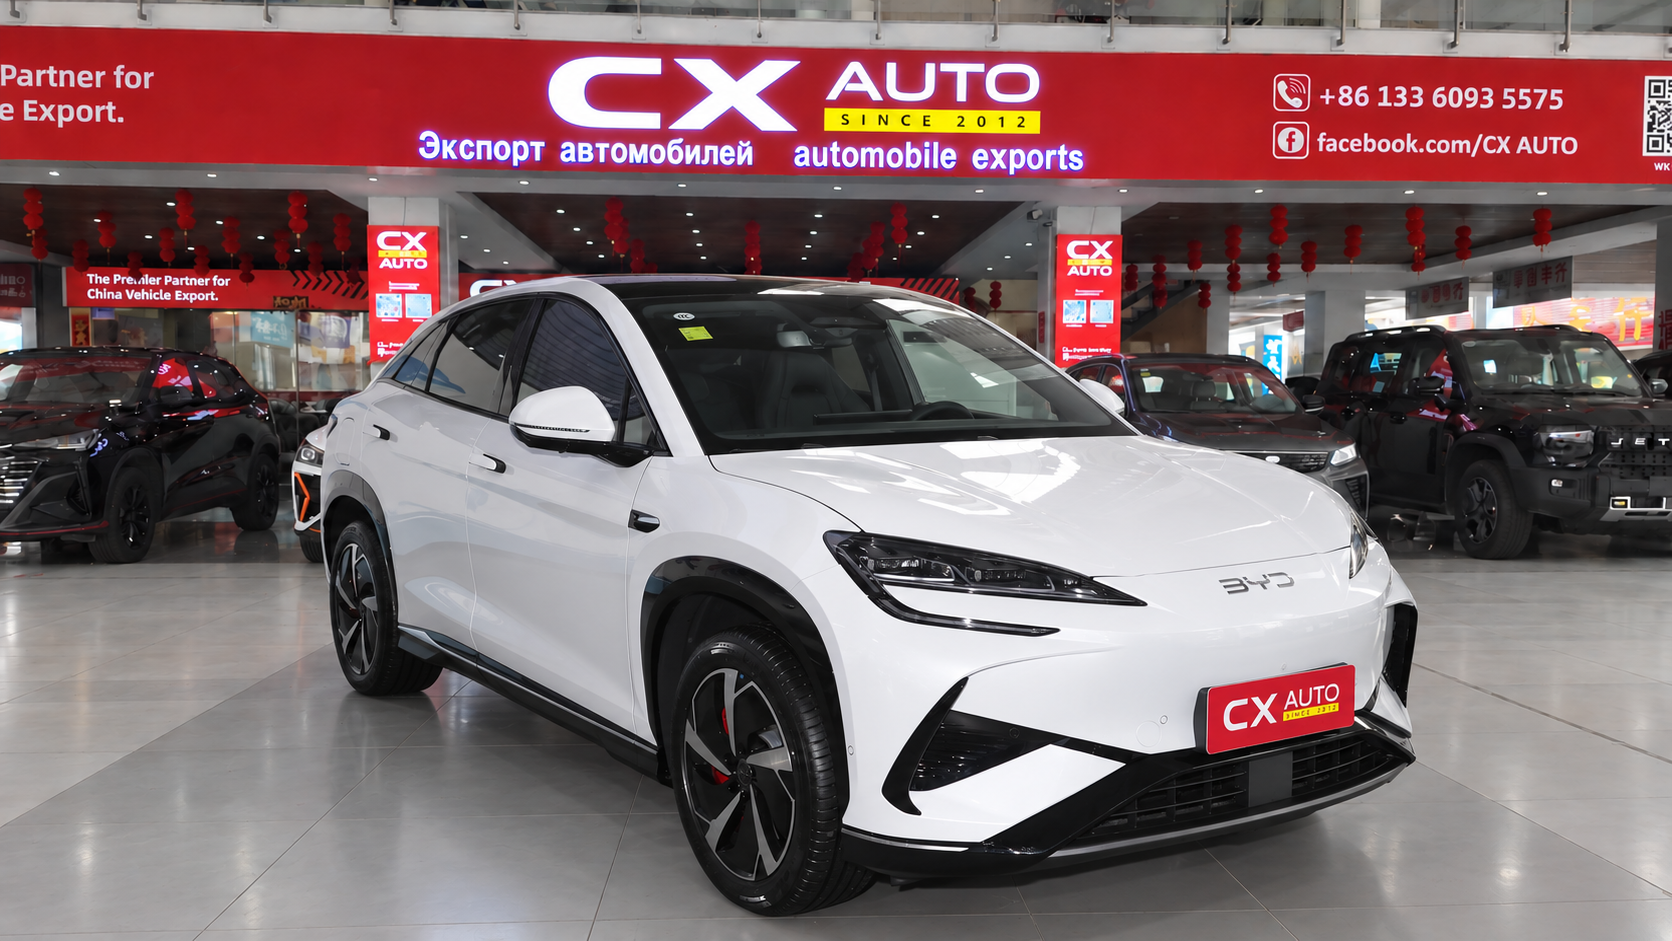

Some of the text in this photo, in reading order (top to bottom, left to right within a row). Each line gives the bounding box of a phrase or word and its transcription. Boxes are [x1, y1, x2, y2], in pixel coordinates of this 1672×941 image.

[1, 65, 154, 89] Partner for
[825, 61, 1040, 103] AUTO
[547, 56, 800, 132] CX
[1319, 86, 1563, 110] +86 133 6093 5575
[23, 100, 124, 128] Export.
[841, 113, 1025, 128] SINCE 2012
[418, 131, 753, 167] Экспорт автомобилей
[1317, 132, 1578, 157] facebook.com/CX AUTO
[793, 141, 1084, 175] automobile exports
[376, 231, 427, 251] CX
[1066, 240, 1113, 259] CX
[379, 258, 428, 269] AUTO
[1067, 266, 1113, 276] AUTO
[87, 274, 110, 285] The
[164, 275, 210, 286] Partner
[212, 275, 231, 287] for
[86, 288, 219, 303] China Vehicle Export.
[1219, 572, 1294, 594] BYD
[1284, 683, 1340, 710] AUTO
[1223, 692, 1278, 731] CX
